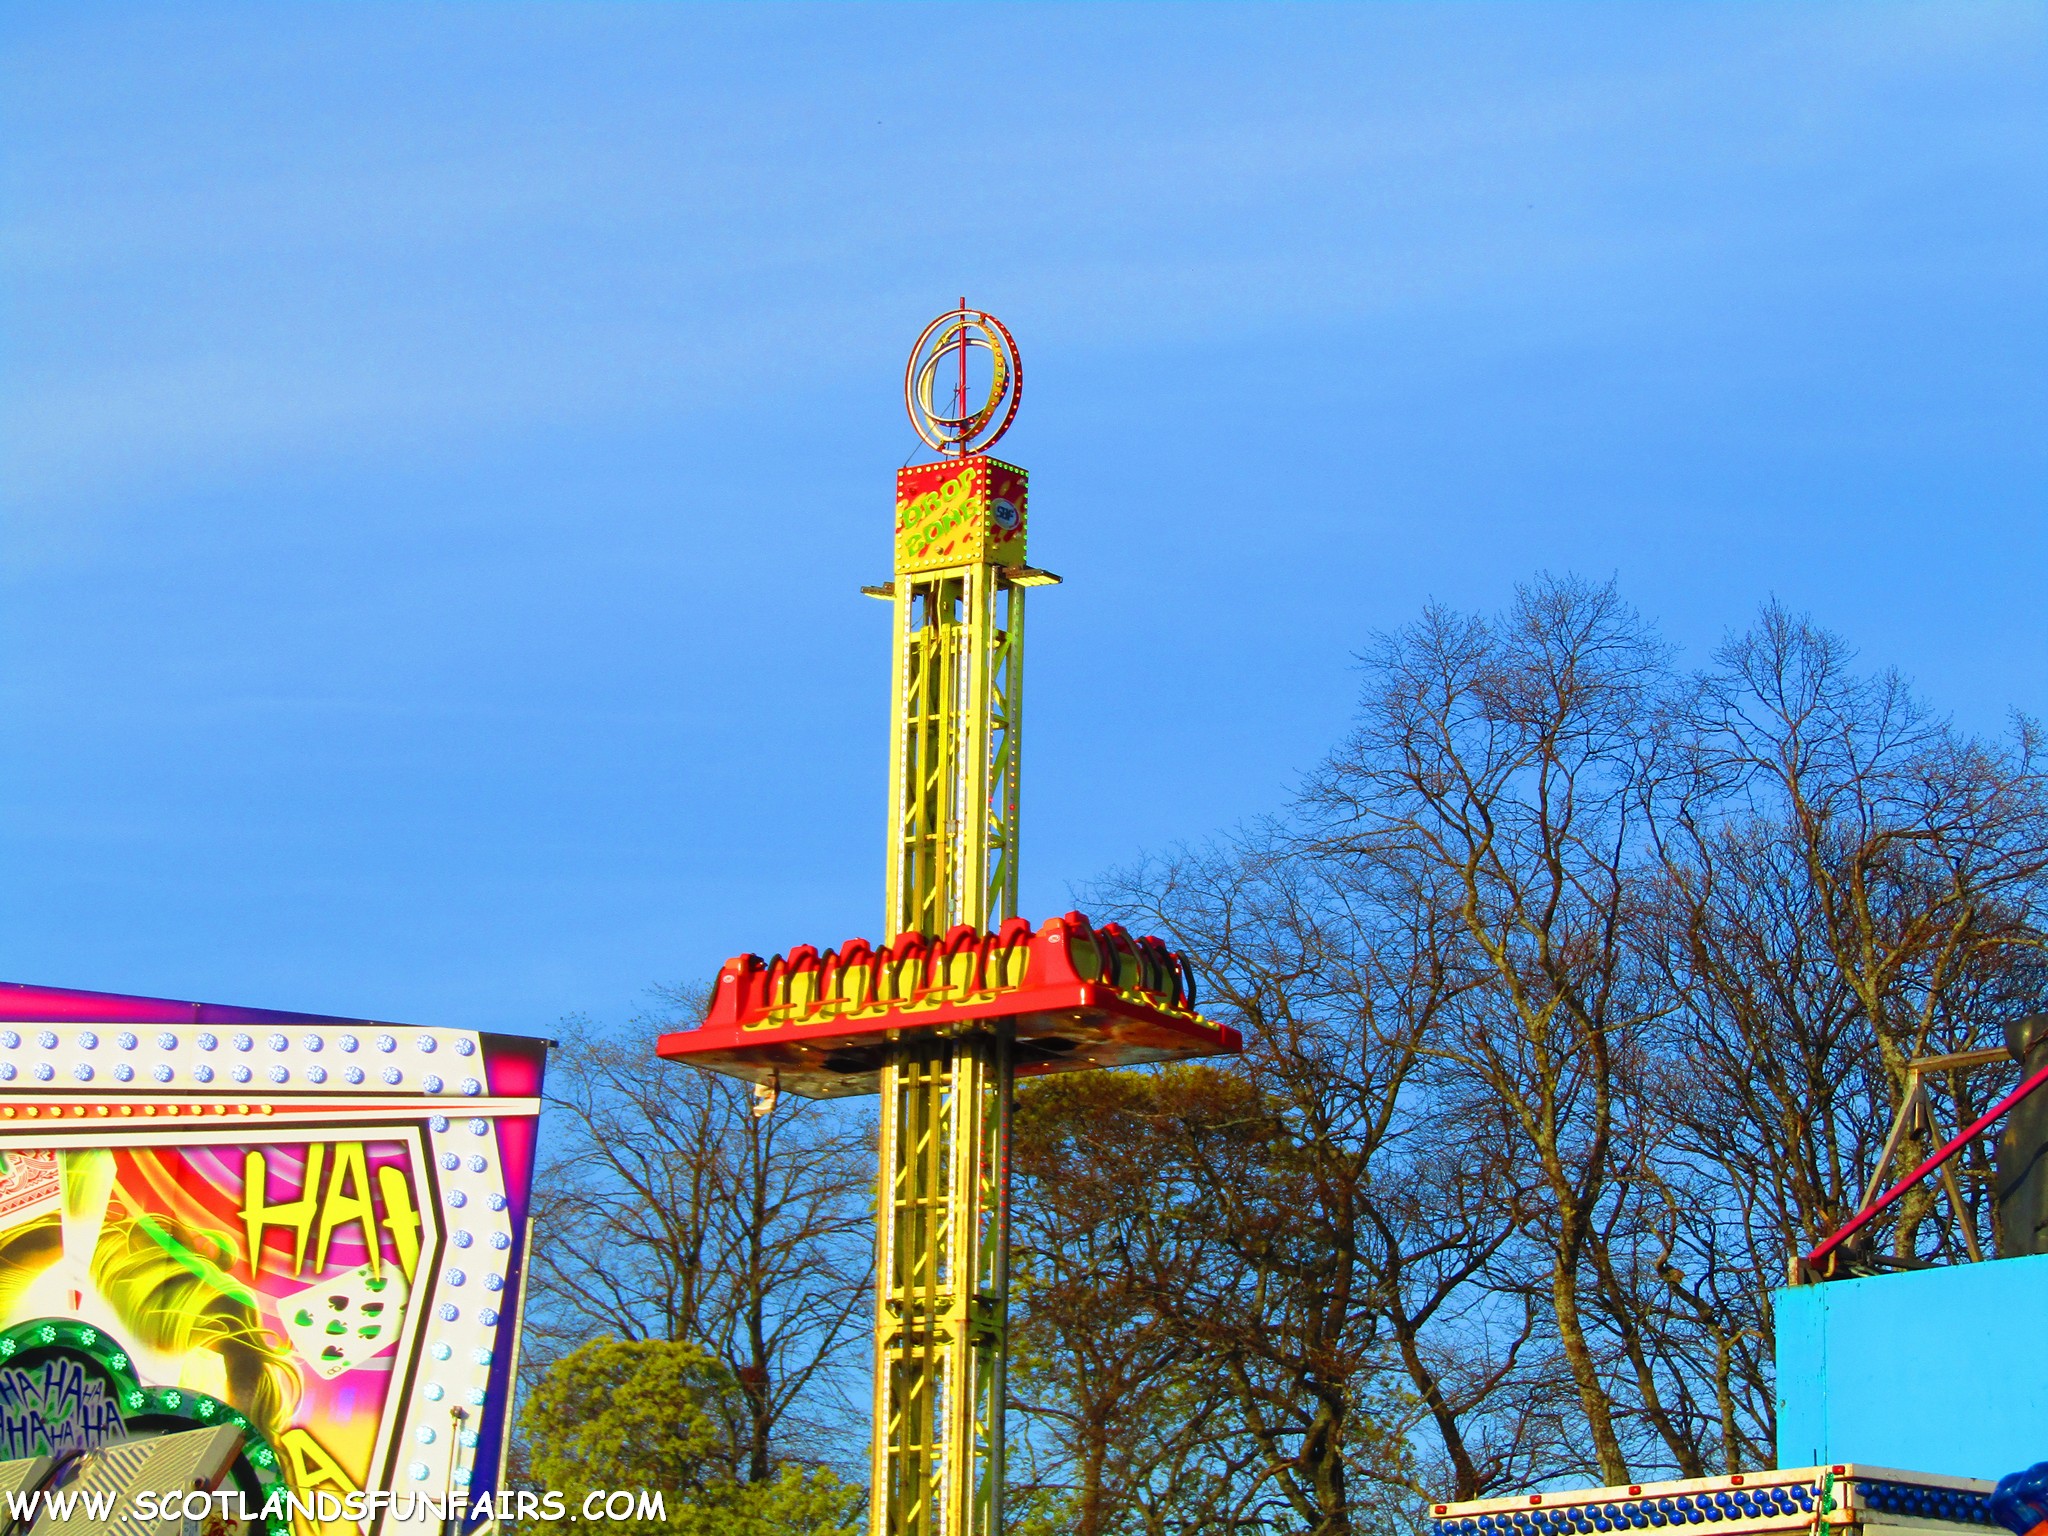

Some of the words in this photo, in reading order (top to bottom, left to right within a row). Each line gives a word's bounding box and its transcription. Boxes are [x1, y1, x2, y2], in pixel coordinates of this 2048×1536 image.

[902, 467, 977, 530] DROP
[43, 1361, 82, 1425] HA
[81, 1400, 127, 1448] HA
